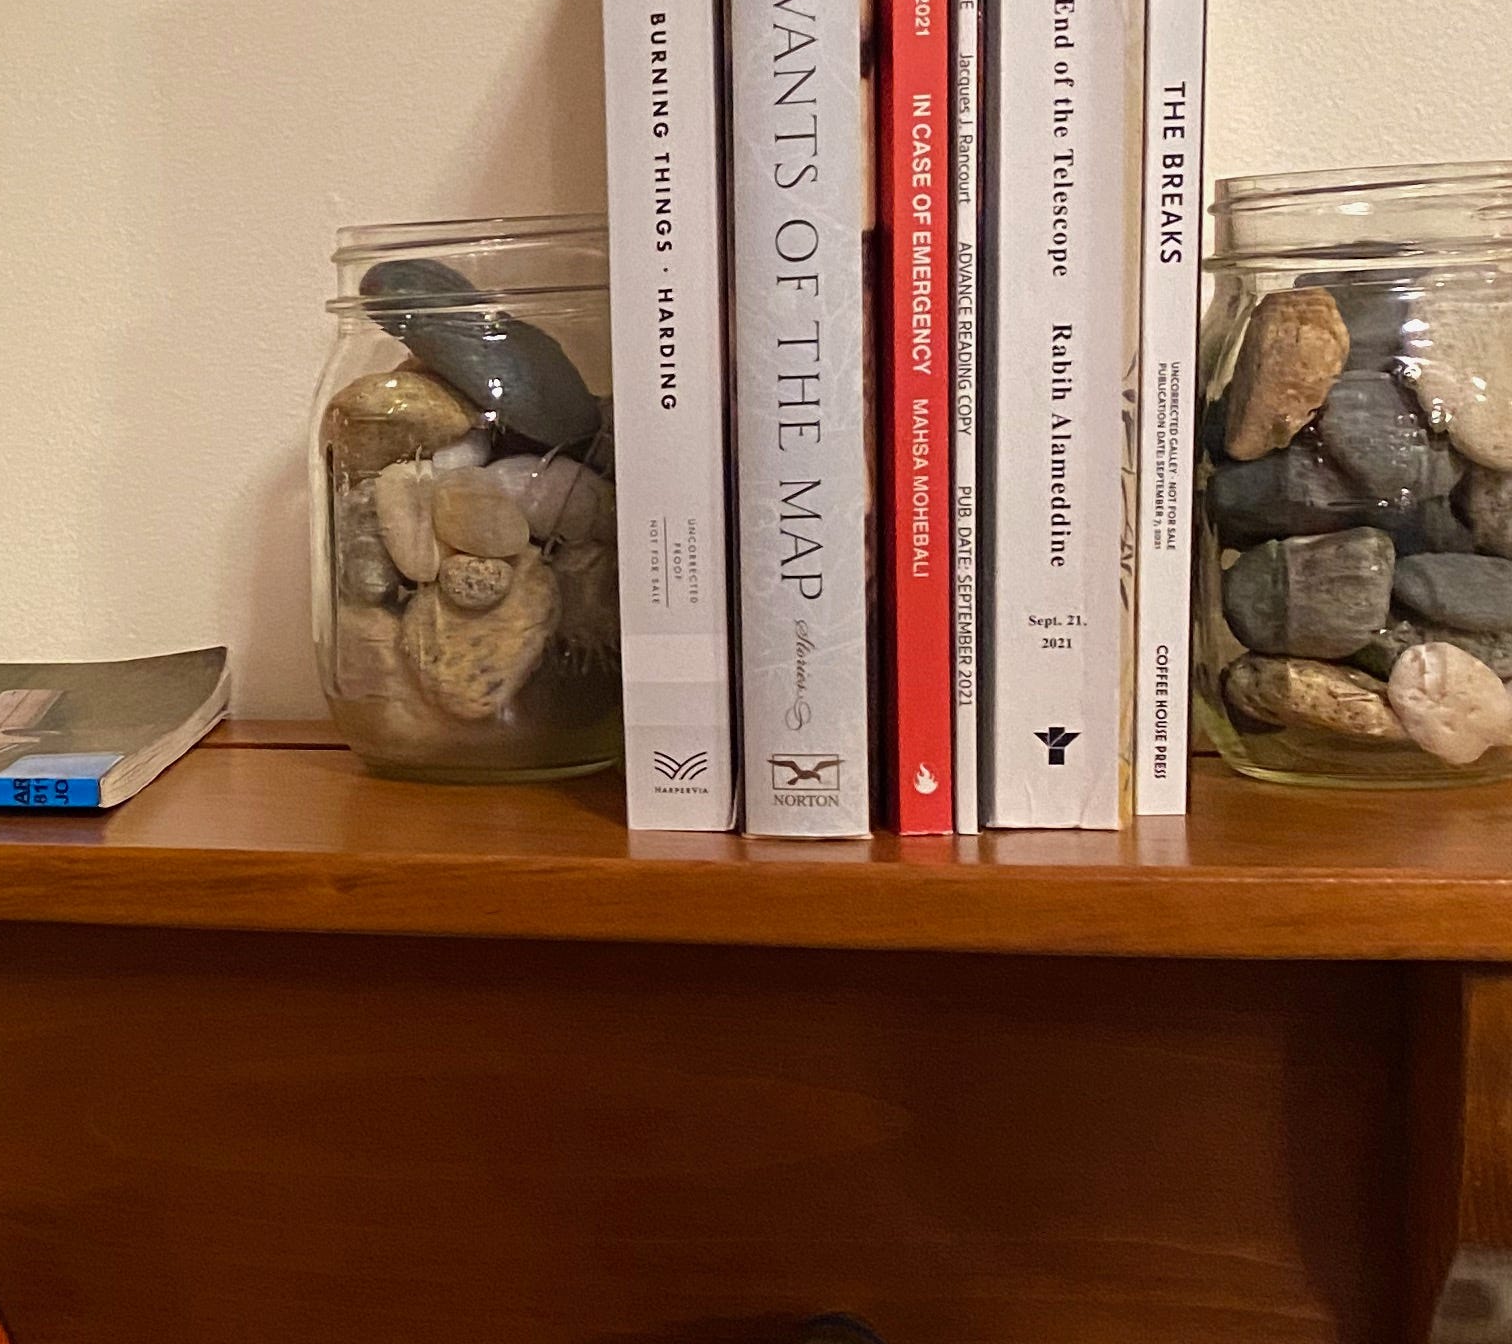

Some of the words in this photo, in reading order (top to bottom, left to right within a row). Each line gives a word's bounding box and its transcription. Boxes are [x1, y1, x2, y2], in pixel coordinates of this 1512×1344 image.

[648, 12, 670, 140] BURNING
[911, 93, 932, 116] IN
[956, 54, 974, 114] Jacques
[1052, 61, 1075, 88] of
[1052, 98, 1074, 138] the
[1162, 81, 1186, 140] THE
[910, 122, 932, 188] CASE
[958, 134, 974, 204] Rancourt
[653, 152, 672, 253] THINGS
[911, 193, 932, 225] OF
[1046, 148, 1074, 278] Telescope
[1159, 153, 1184, 264] BREAKS
[772, 218, 820, 298] OF
[956, 242, 973, 316] ADVANCE
[910, 230, 932, 376] EMERGENCY
[656, 288, 677, 411] HARDING
[956, 320, 973, 390] READING
[1050, 323, 1074, 402] Rabih
[774, 318, 822, 452] THE
[956, 394, 972, 436] COPY
[1156, 362, 1167, 428] PUBLICATION
[1168, 361, 1180, 435] UNCORRECTED
[911, 398, 930, 470] MAHSA
[1167, 437, 1178, 474] GALLEY
[956, 486, 972, 522] PUB.
[1049, 412, 1073, 568] Alameddine
[1154, 460, 1165, 517] SEPTEMBER
[1166, 481, 1178, 503] NOT
[1166, 505, 1177, 526] FOR
[776, 478, 824, 600] MAP
[911, 474, 930, 578] MOHEBALI
[956, 526, 972, 570] DATE:
[1165, 527, 1176, 551] SALE
[686, 518, 698, 604] UNCORRECTED
[956, 574, 972, 665] SEPTEMBER
[1028, 614, 1062, 628] Sept.
[1041, 638, 1072, 649] 2021
[788, 618, 816, 714] Stories
[957, 669, 972, 706] 2021
[1154, 644, 1169, 696] COFFEE
[1154, 700, 1168, 742] HOUSE
[1153, 746, 1167, 779] PRESS
[774, 794, 839, 807] NORTON
